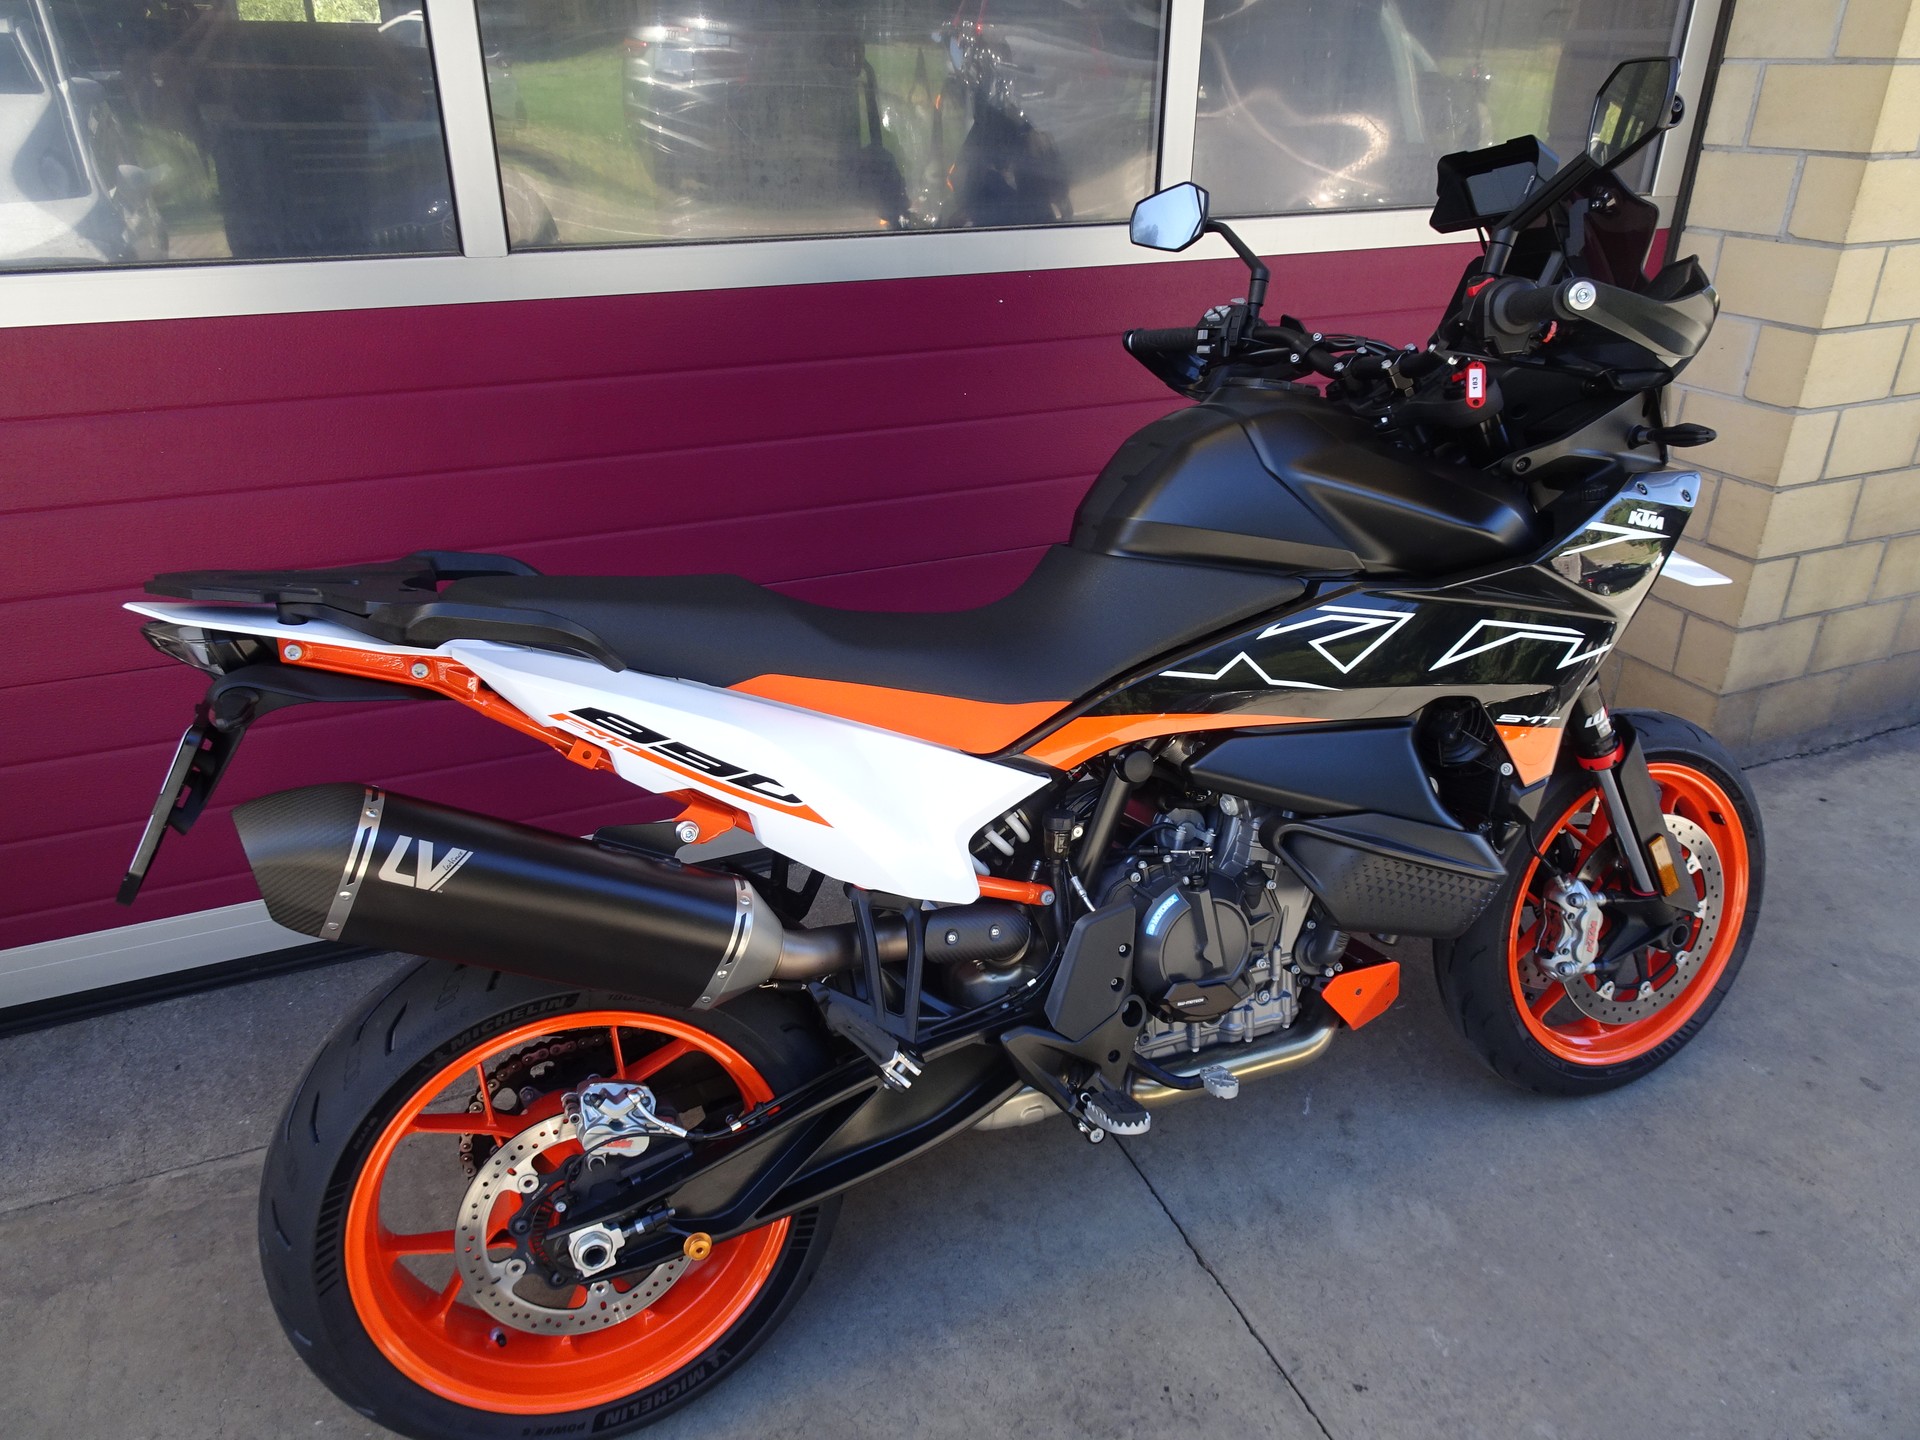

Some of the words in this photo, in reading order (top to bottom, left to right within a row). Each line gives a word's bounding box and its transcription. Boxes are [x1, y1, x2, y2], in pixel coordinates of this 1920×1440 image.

[1628, 508, 1665, 530] KTM
[1496, 713, 1561, 725] SMT
[450, 996, 567, 1052] MICHELIN
[603, 1363, 706, 1427] MICHELIN
[535, 1421, 586, 1437] POWER
